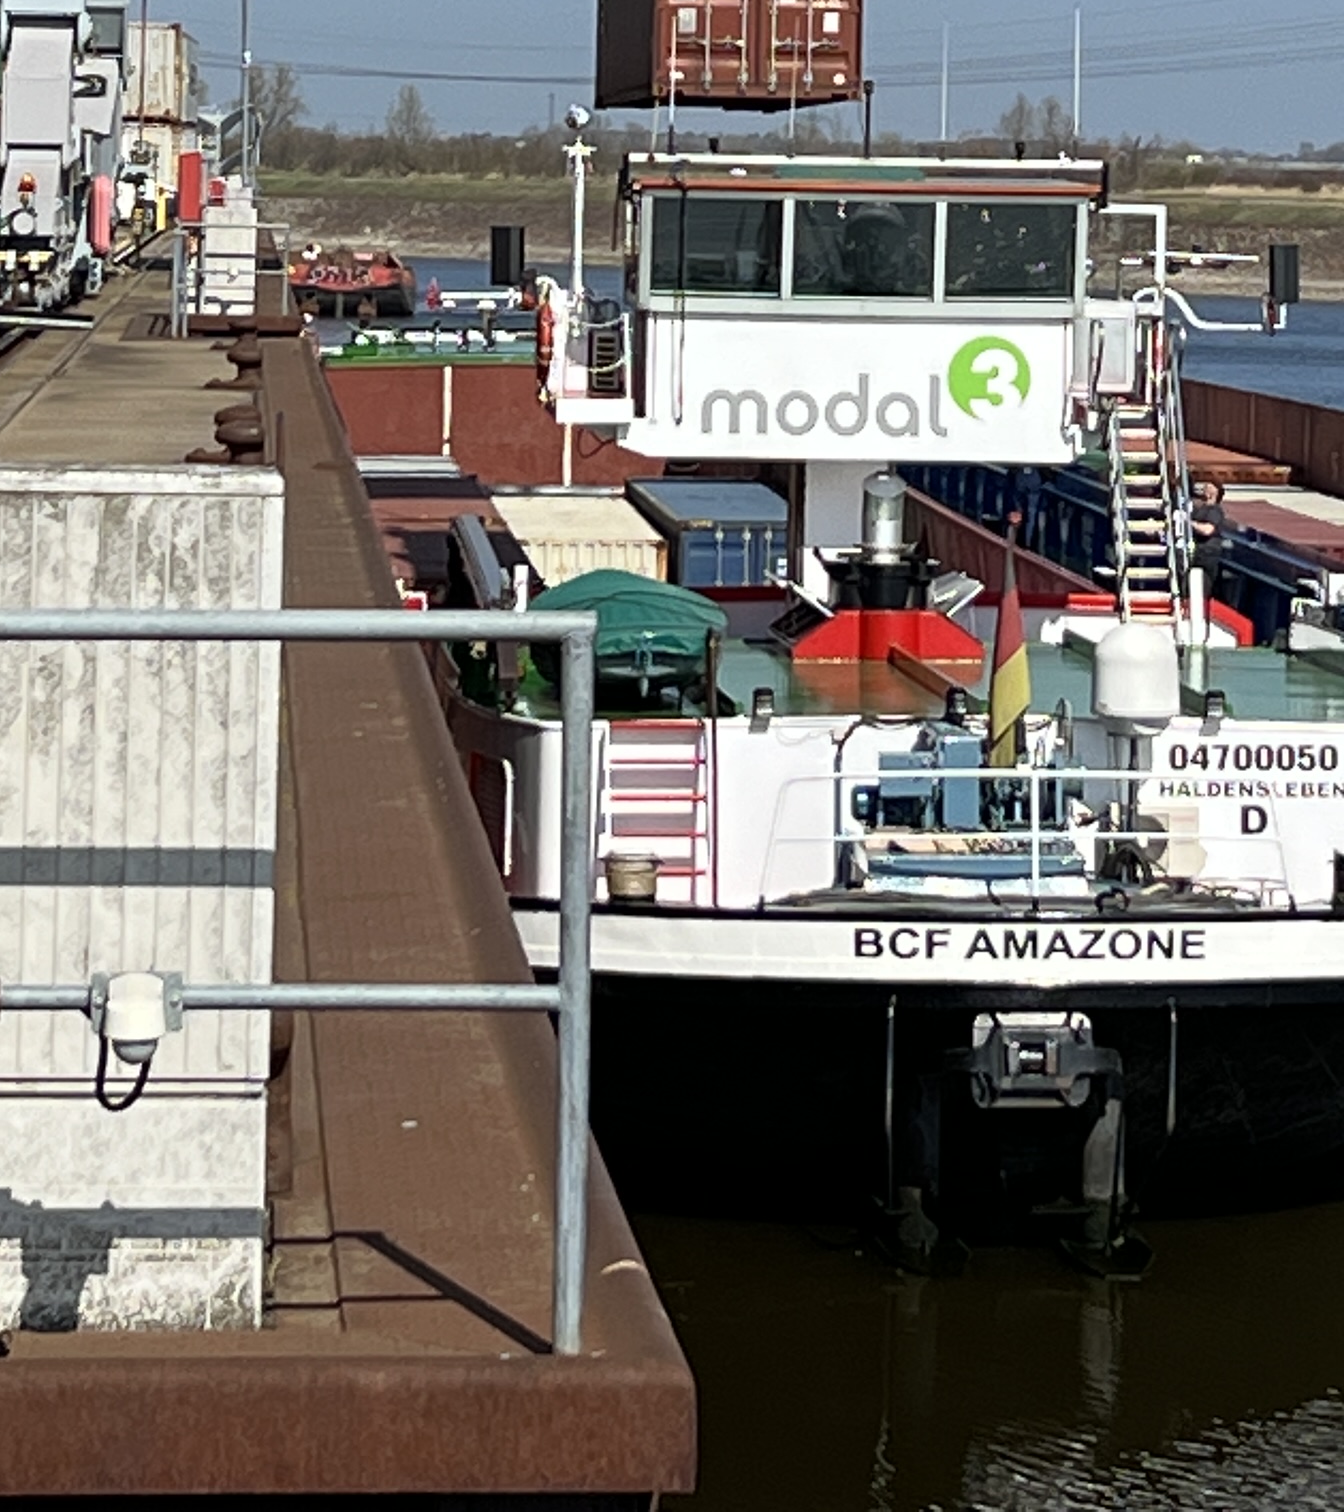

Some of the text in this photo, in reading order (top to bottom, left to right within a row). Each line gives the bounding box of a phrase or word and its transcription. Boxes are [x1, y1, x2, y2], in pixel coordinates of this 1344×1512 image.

[700, 344, 1025, 438] modal 3
[1169, 744, 1338, 771] 04700050
[1241, 804, 1268, 835] D
[853, 927, 1207, 961] BCF AMAZONE
